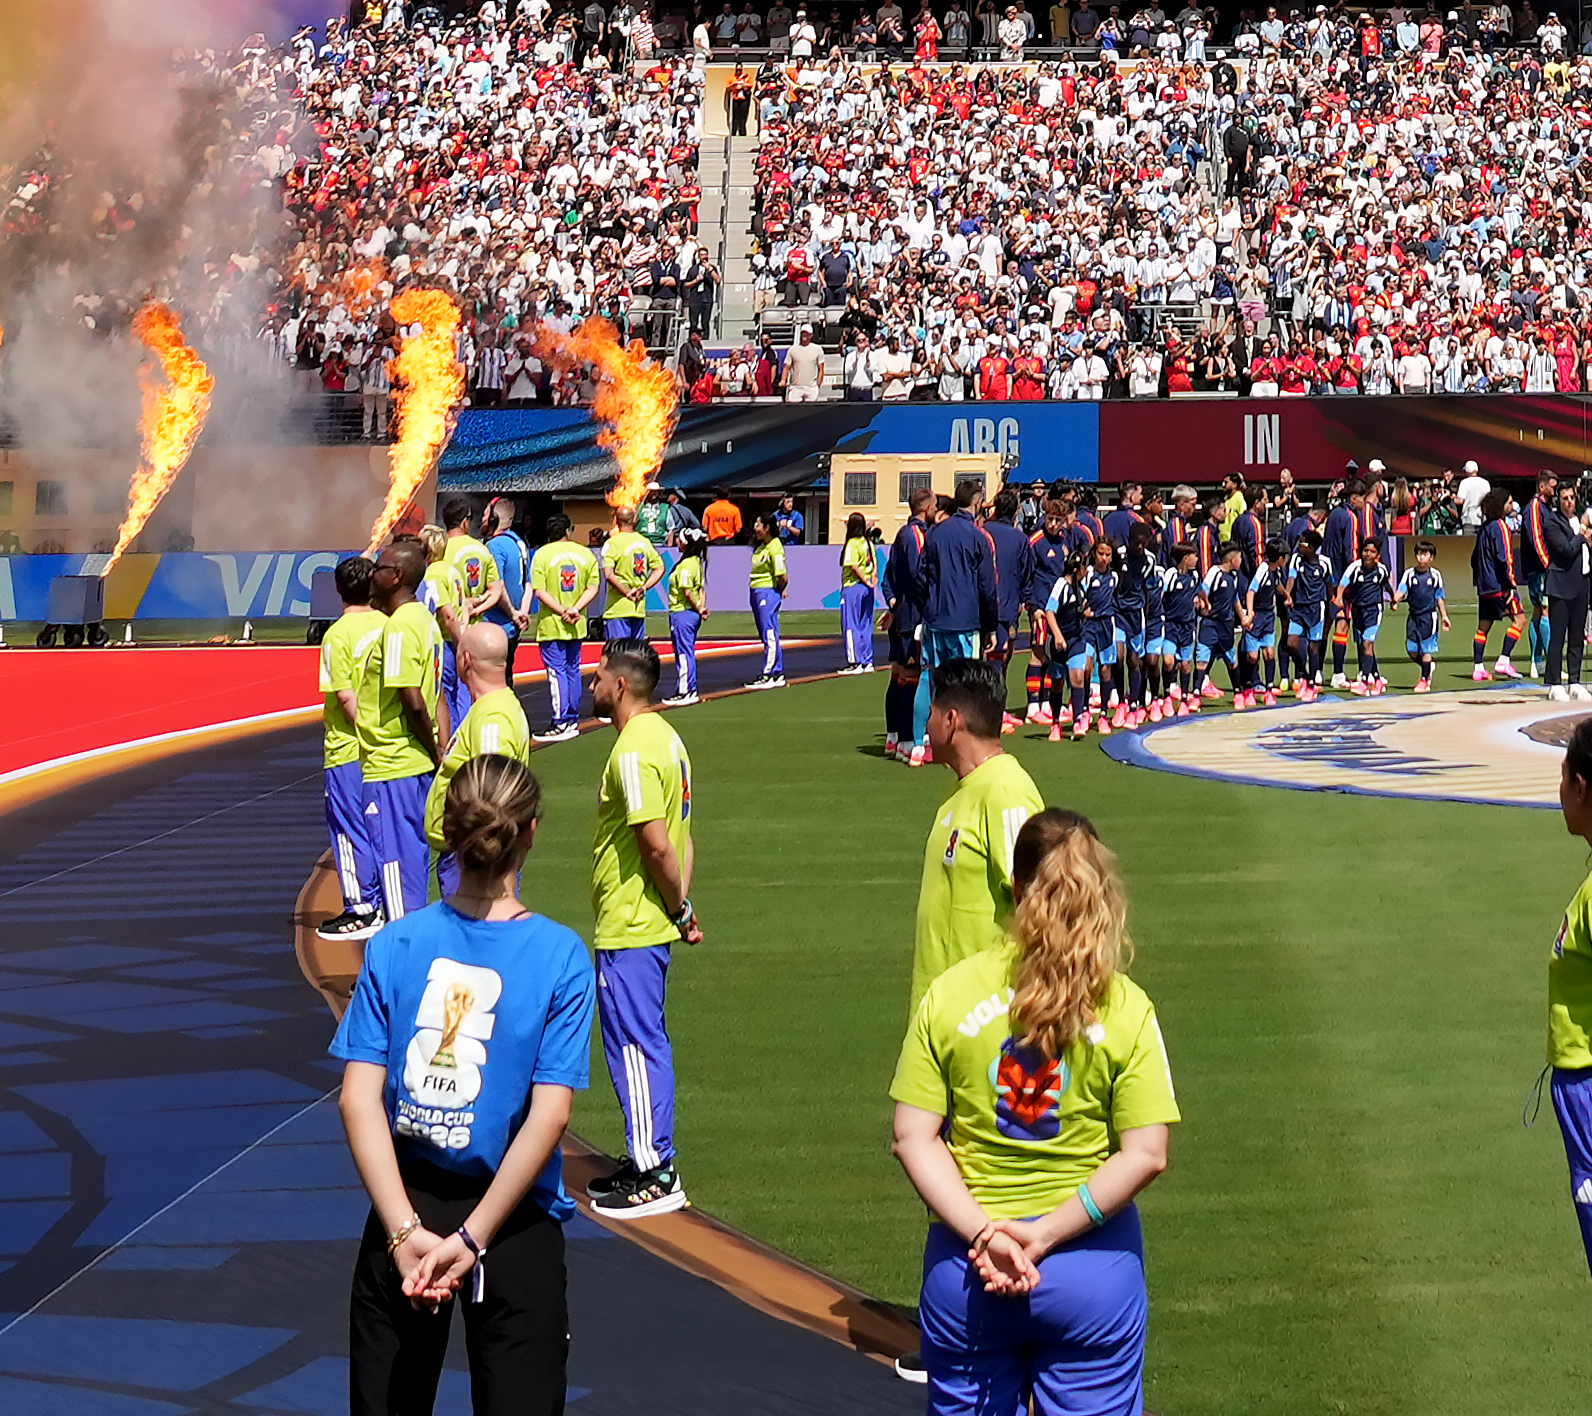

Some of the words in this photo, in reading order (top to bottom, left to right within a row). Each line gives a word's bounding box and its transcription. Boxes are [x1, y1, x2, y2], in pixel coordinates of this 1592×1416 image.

[949, 417, 1020, 457] ARG
[1243, 413, 1281, 465] IN
[203, 551, 340, 619] VIS
[422, 1074, 457, 1093] FIFA
[398, 1099, 444, 1125] WORLD
[443, 1111, 475, 1127] CUP
[396, 1114, 471, 1151] 2026
